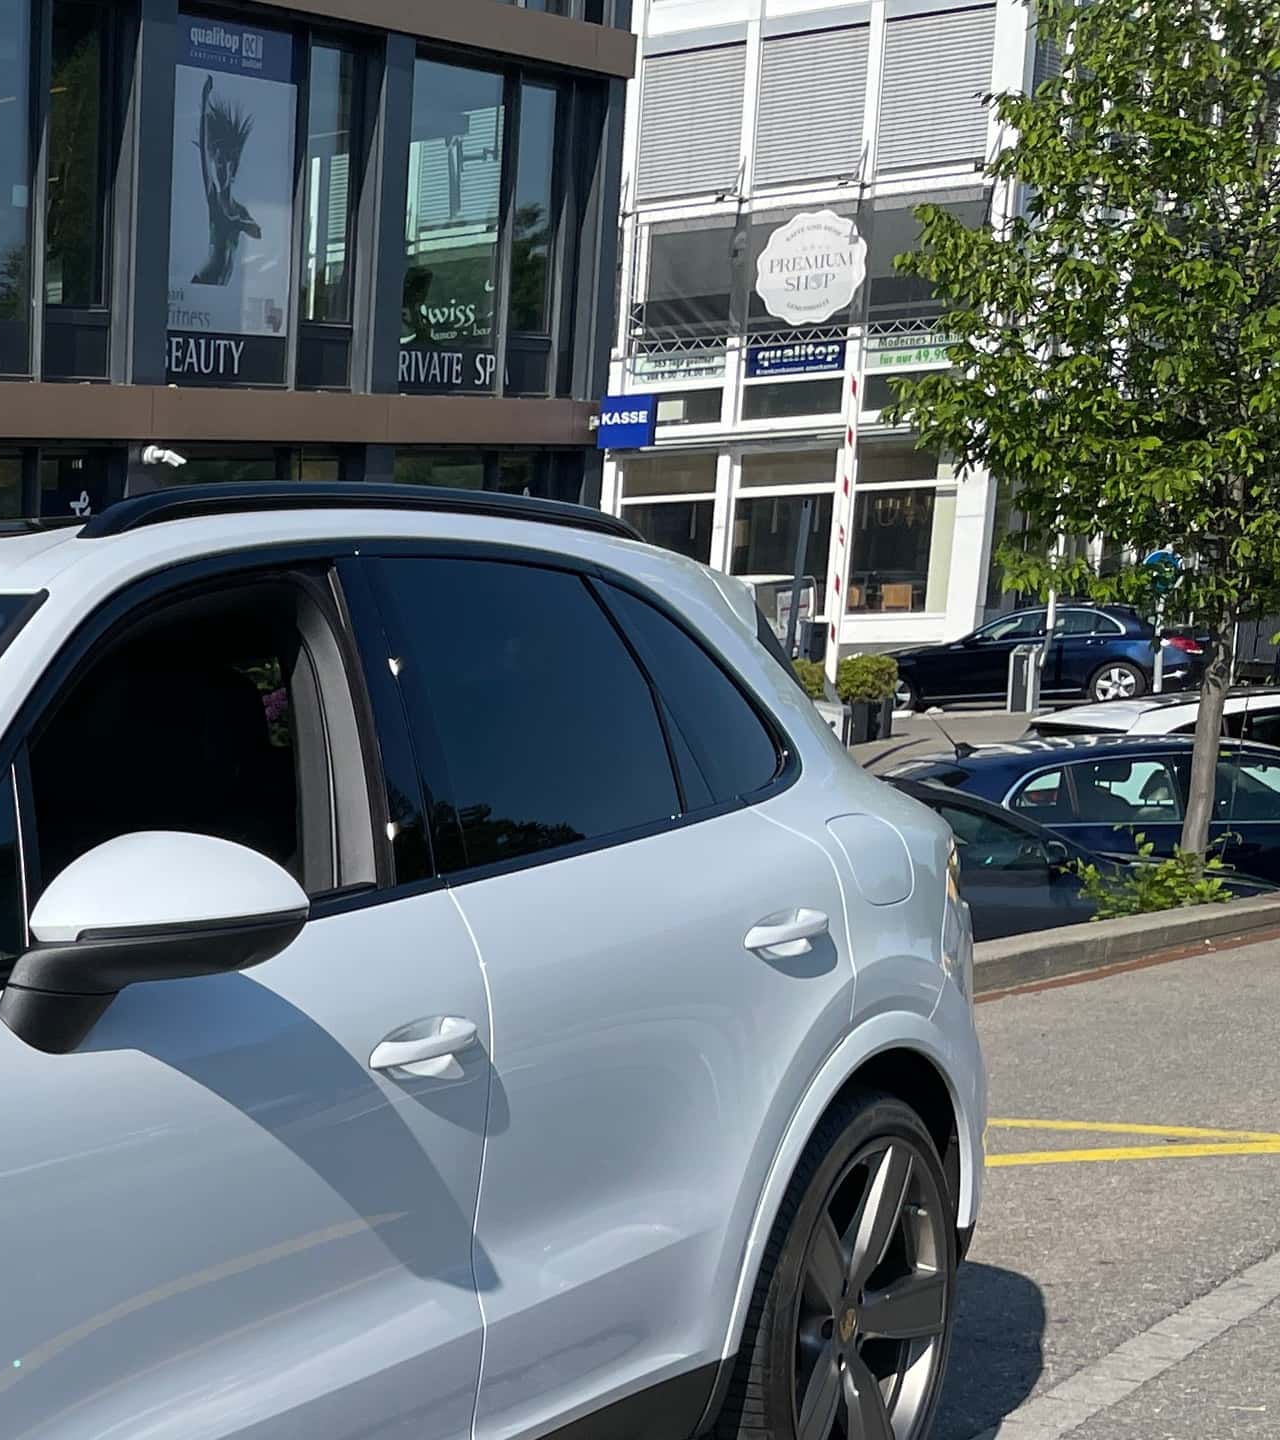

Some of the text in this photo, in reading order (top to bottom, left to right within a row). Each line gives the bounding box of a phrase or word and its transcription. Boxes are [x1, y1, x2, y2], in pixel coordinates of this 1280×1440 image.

[190, 27, 240, 54] qualitop
[769, 250, 854, 274] PREMIUM
[784, 273, 836, 292] SHOP
[165, 336, 245, 375] EAUTY
[756, 343, 840, 367] qualitop
[473, 353, 510, 385] SP
[601, 410, 648, 426] KASSE
